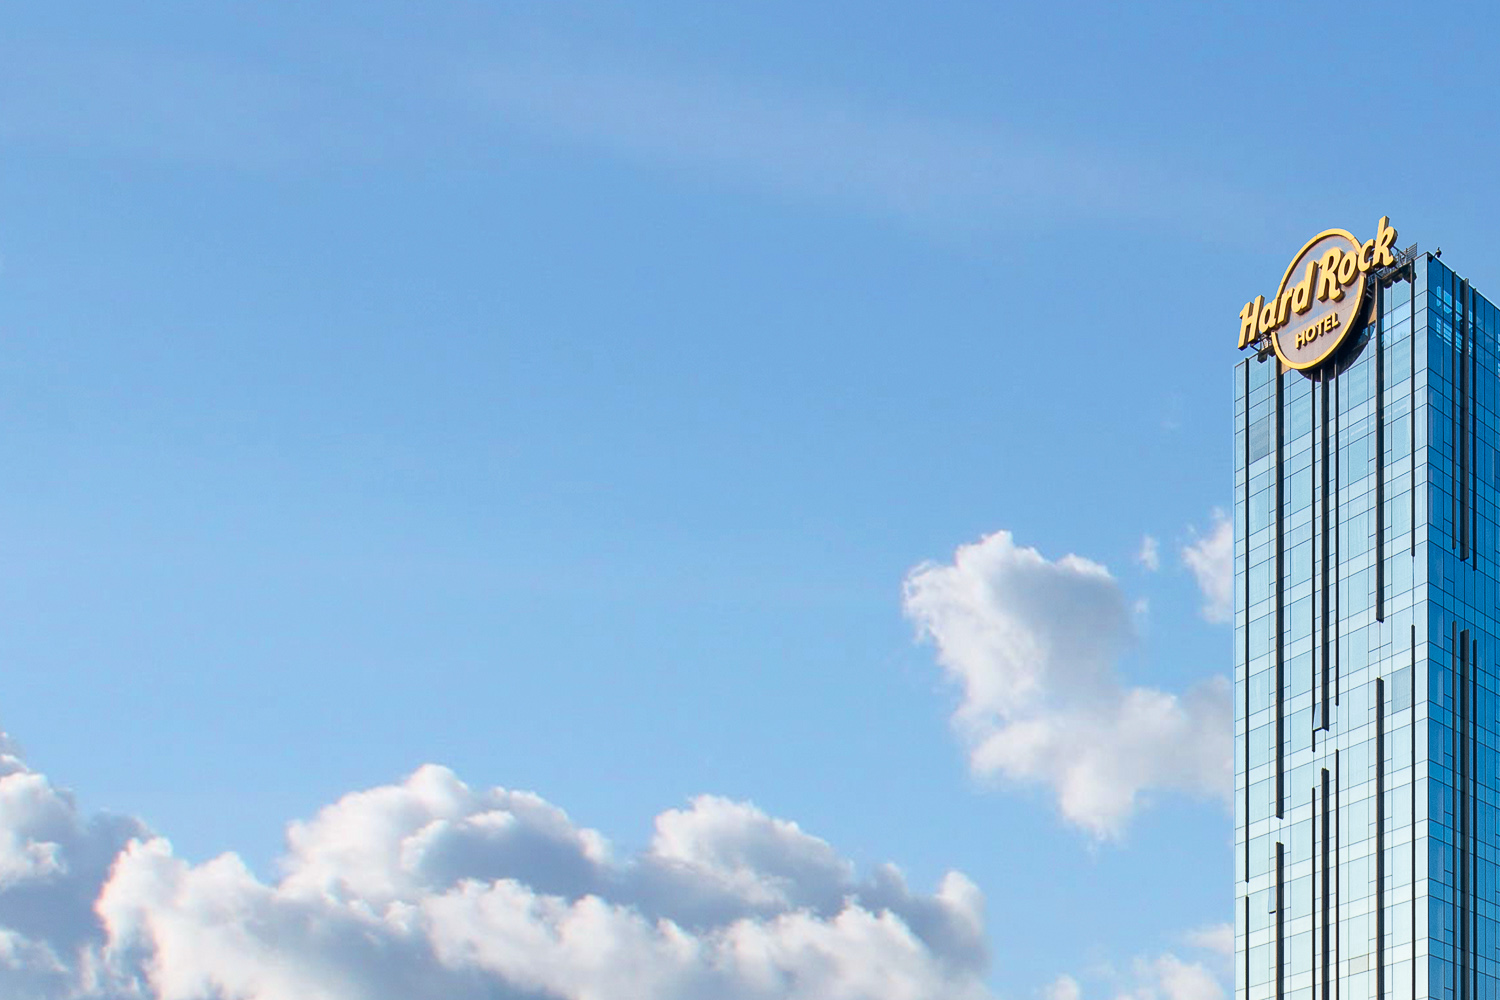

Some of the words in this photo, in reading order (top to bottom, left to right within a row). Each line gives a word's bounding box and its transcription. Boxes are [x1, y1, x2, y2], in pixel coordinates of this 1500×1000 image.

[1238, 260, 1319, 350] Hard
[1317, 216, 1398, 302] Rock
[1295, 312, 1341, 349] HOTEL
